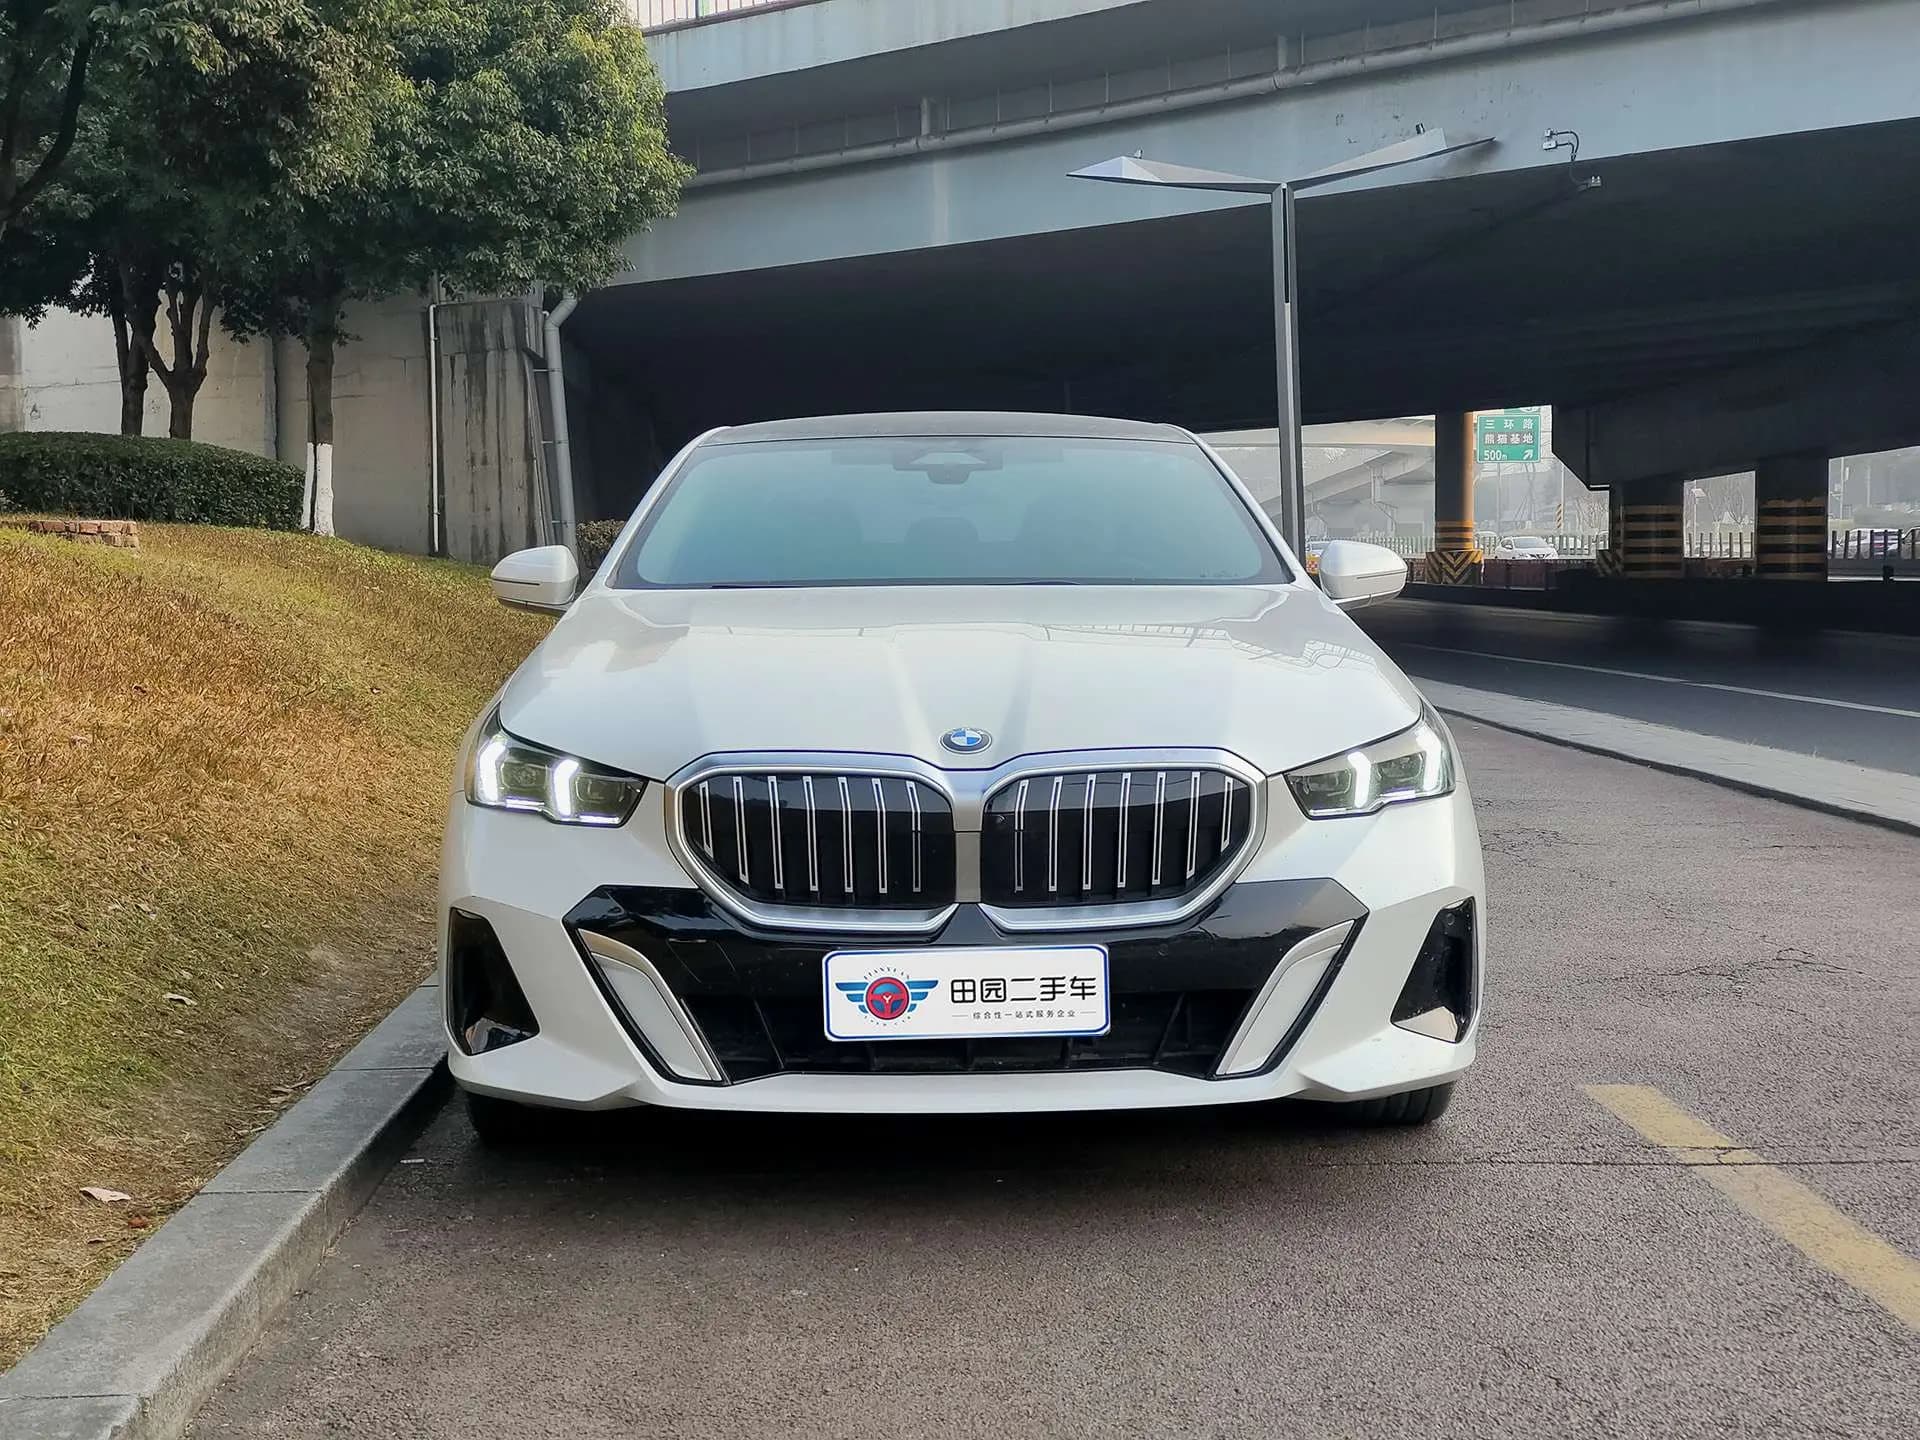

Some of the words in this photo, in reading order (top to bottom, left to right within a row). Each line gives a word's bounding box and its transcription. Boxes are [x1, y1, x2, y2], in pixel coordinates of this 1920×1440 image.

[1485, 418, 1534, 429] 三环路
[1485, 433, 1534, 444] 熊猫基地
[951, 976, 1096, 1003] 田园二手车
[973, 1009, 1076, 1019] 综合性一站式服务企业
